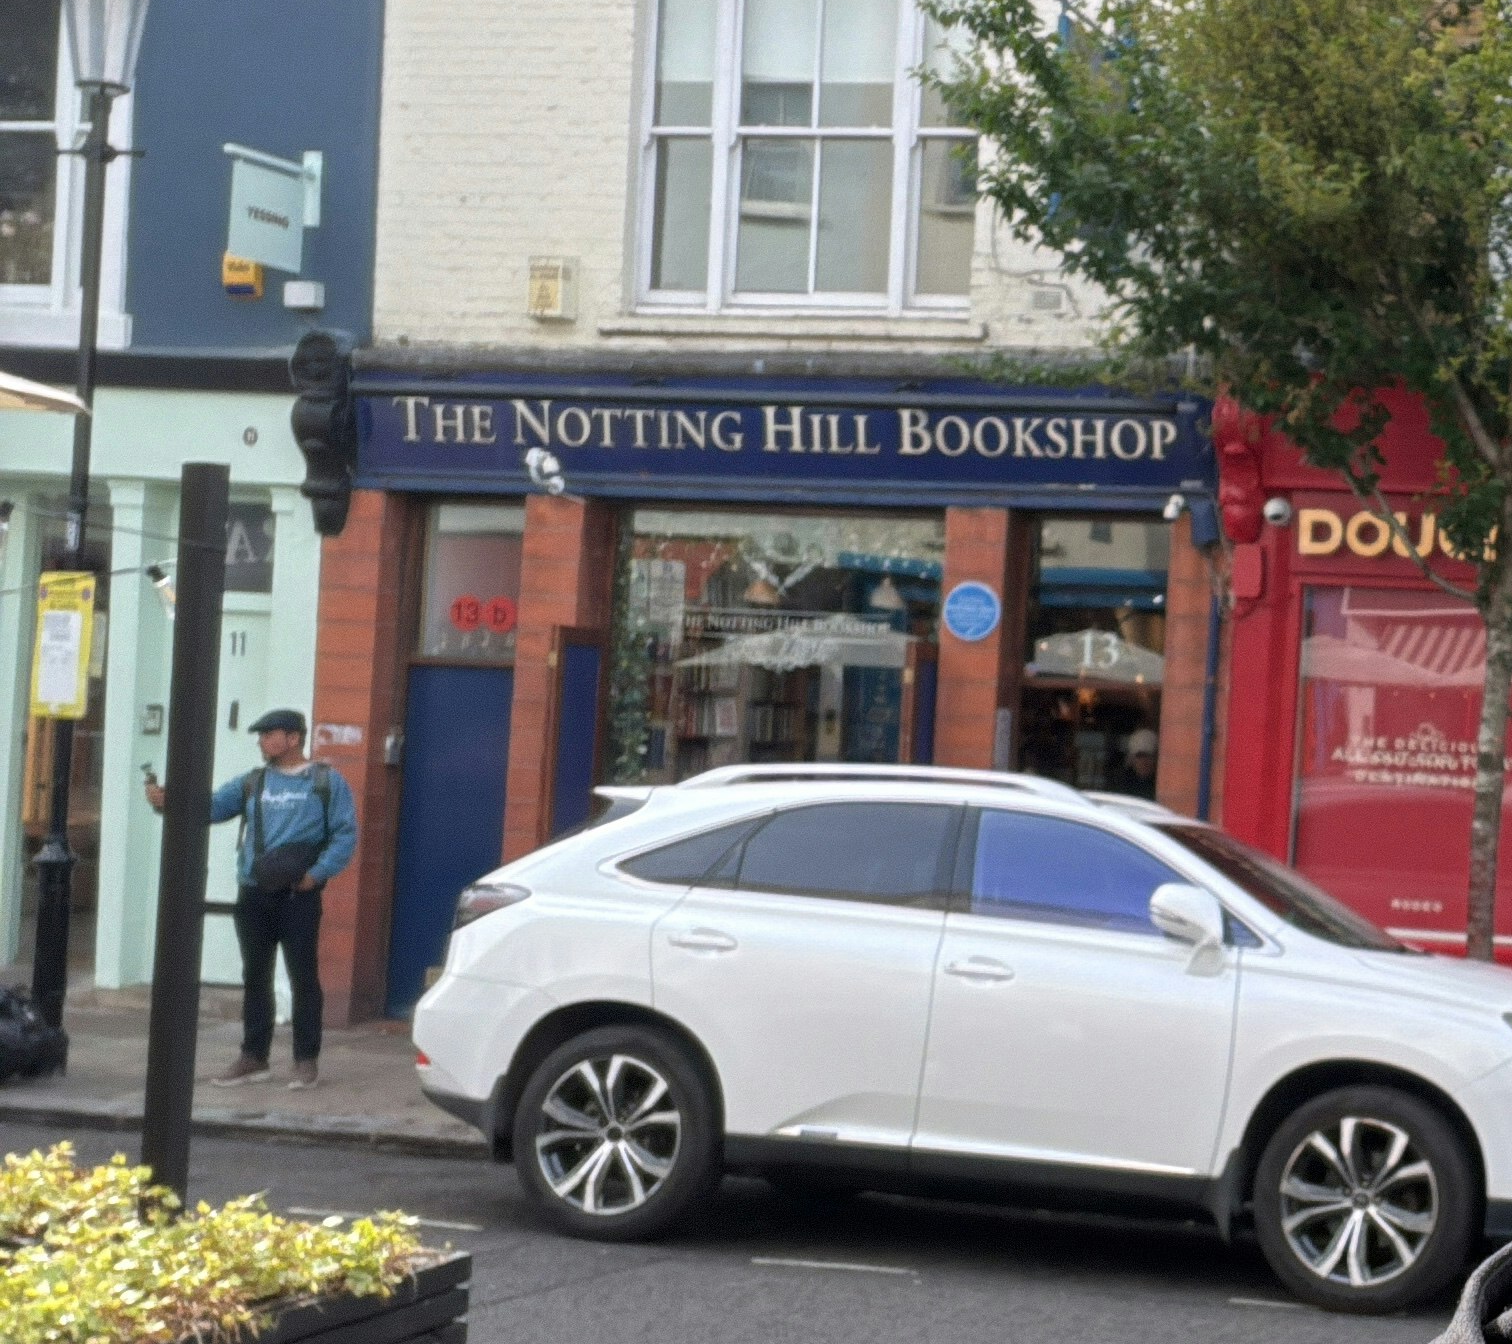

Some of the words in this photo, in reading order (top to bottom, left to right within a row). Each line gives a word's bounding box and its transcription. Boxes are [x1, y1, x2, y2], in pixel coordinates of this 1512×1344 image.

[392, 395, 497, 445] THE
[511, 399, 744, 451] NOTTING
[761, 405, 880, 454] HILL
[898, 408, 1177, 459] BOOKSHOP
[230, 631, 246, 655] 11
[1081, 628, 1121, 668] 13
